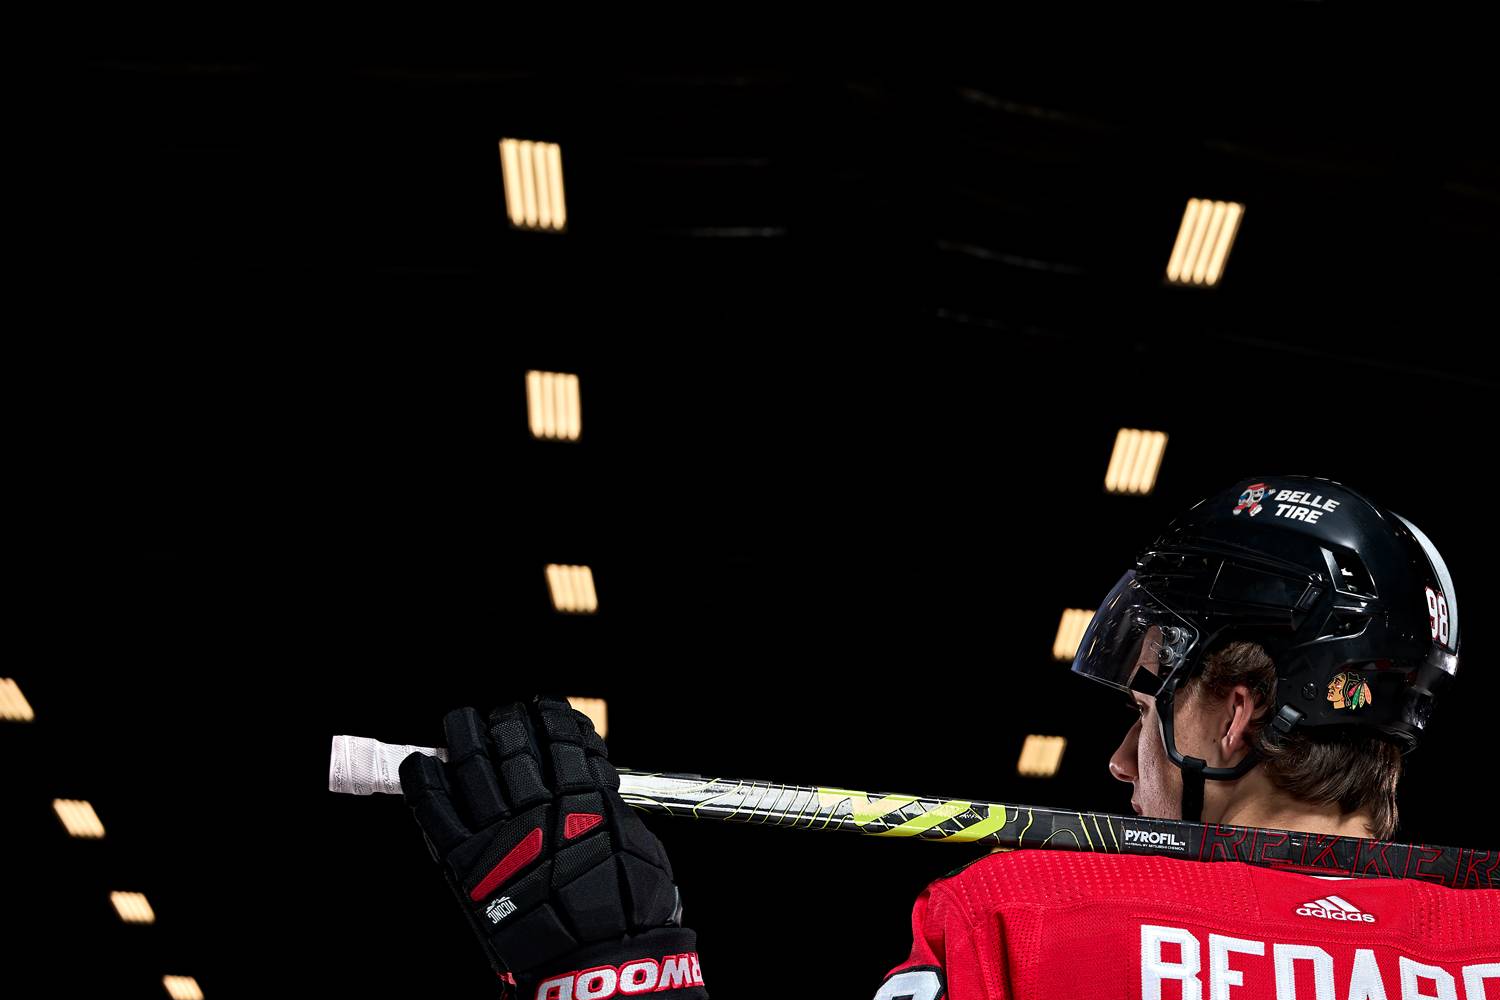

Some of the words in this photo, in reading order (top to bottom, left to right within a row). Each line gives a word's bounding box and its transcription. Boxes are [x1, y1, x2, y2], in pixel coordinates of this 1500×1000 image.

[1274, 489, 1340, 513] BELLE
[1275, 503, 1323, 524] TIRE
[1425, 585, 1449, 647] 98
[487, 899, 517, 924] VICONIC
[1296, 905, 1376, 924] adidas
